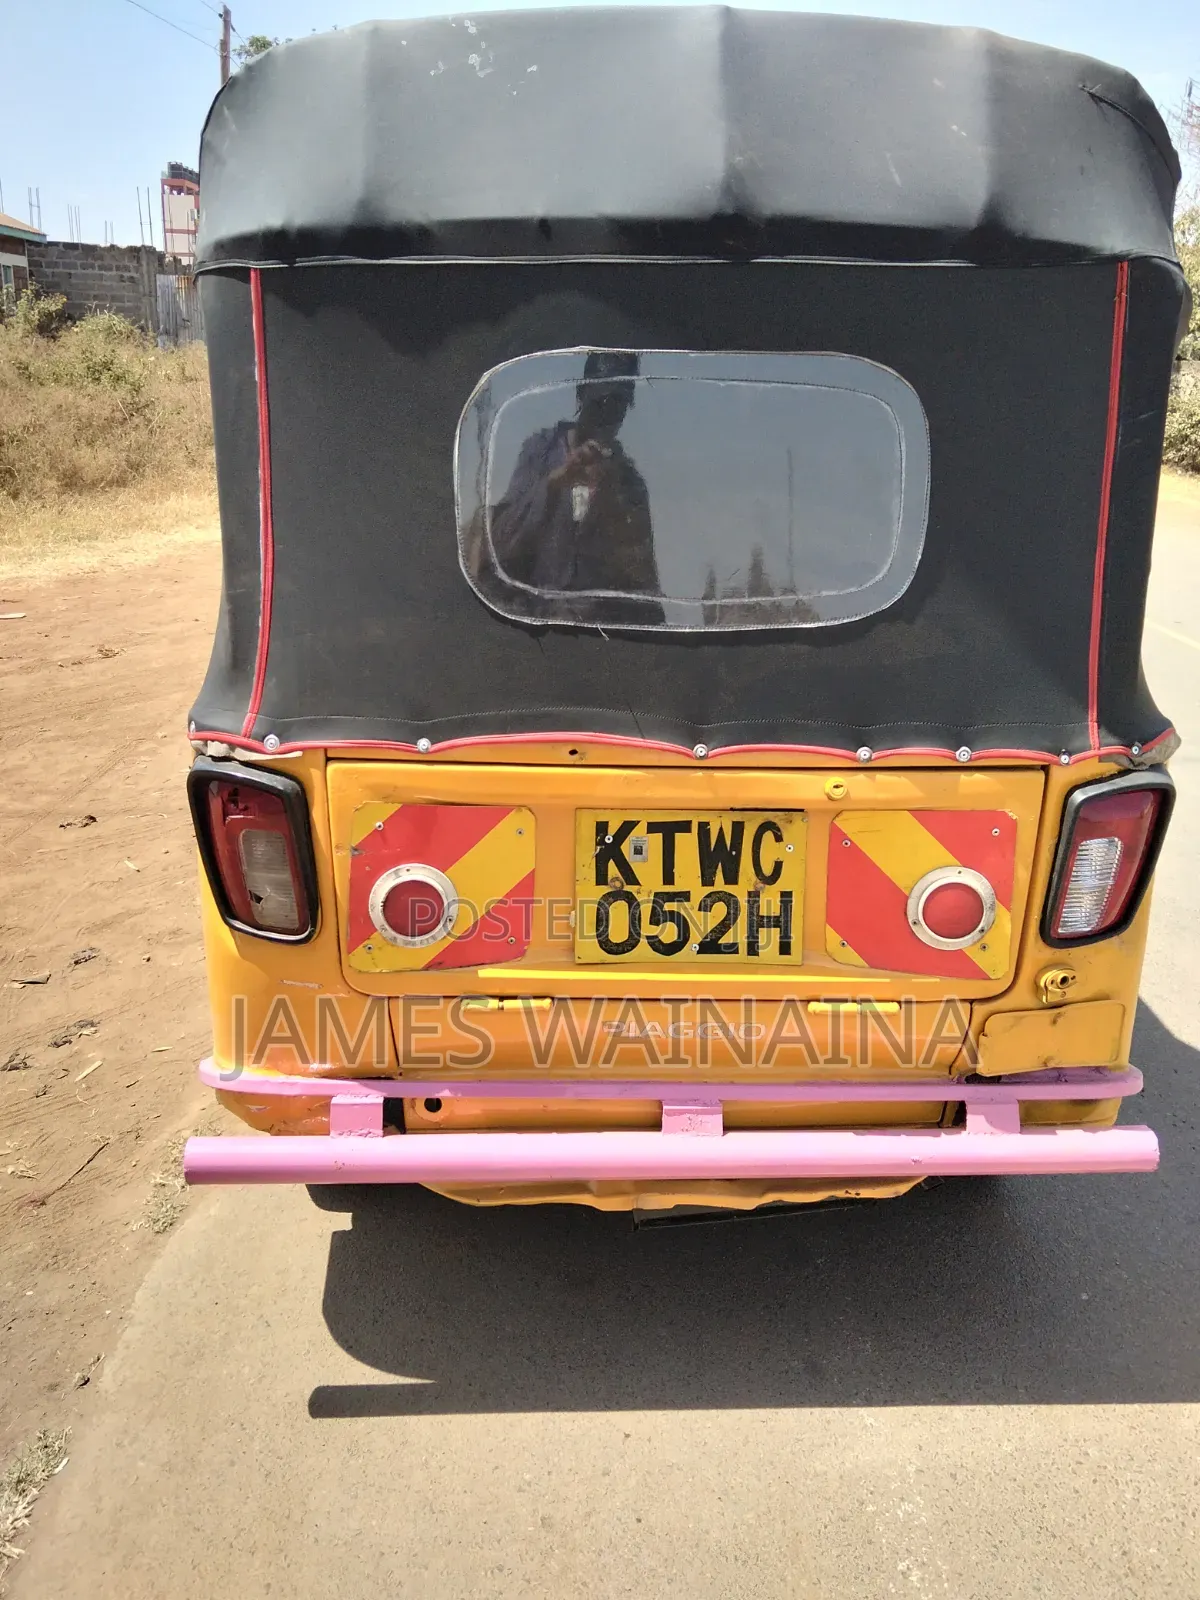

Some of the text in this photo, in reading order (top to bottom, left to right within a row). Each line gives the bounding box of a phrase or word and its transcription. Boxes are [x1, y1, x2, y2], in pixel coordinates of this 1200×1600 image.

[595, 820, 785, 887] KTWC
[595, 890, 794, 957] 052H
[602, 1020, 767, 1041] PIAGGIO
